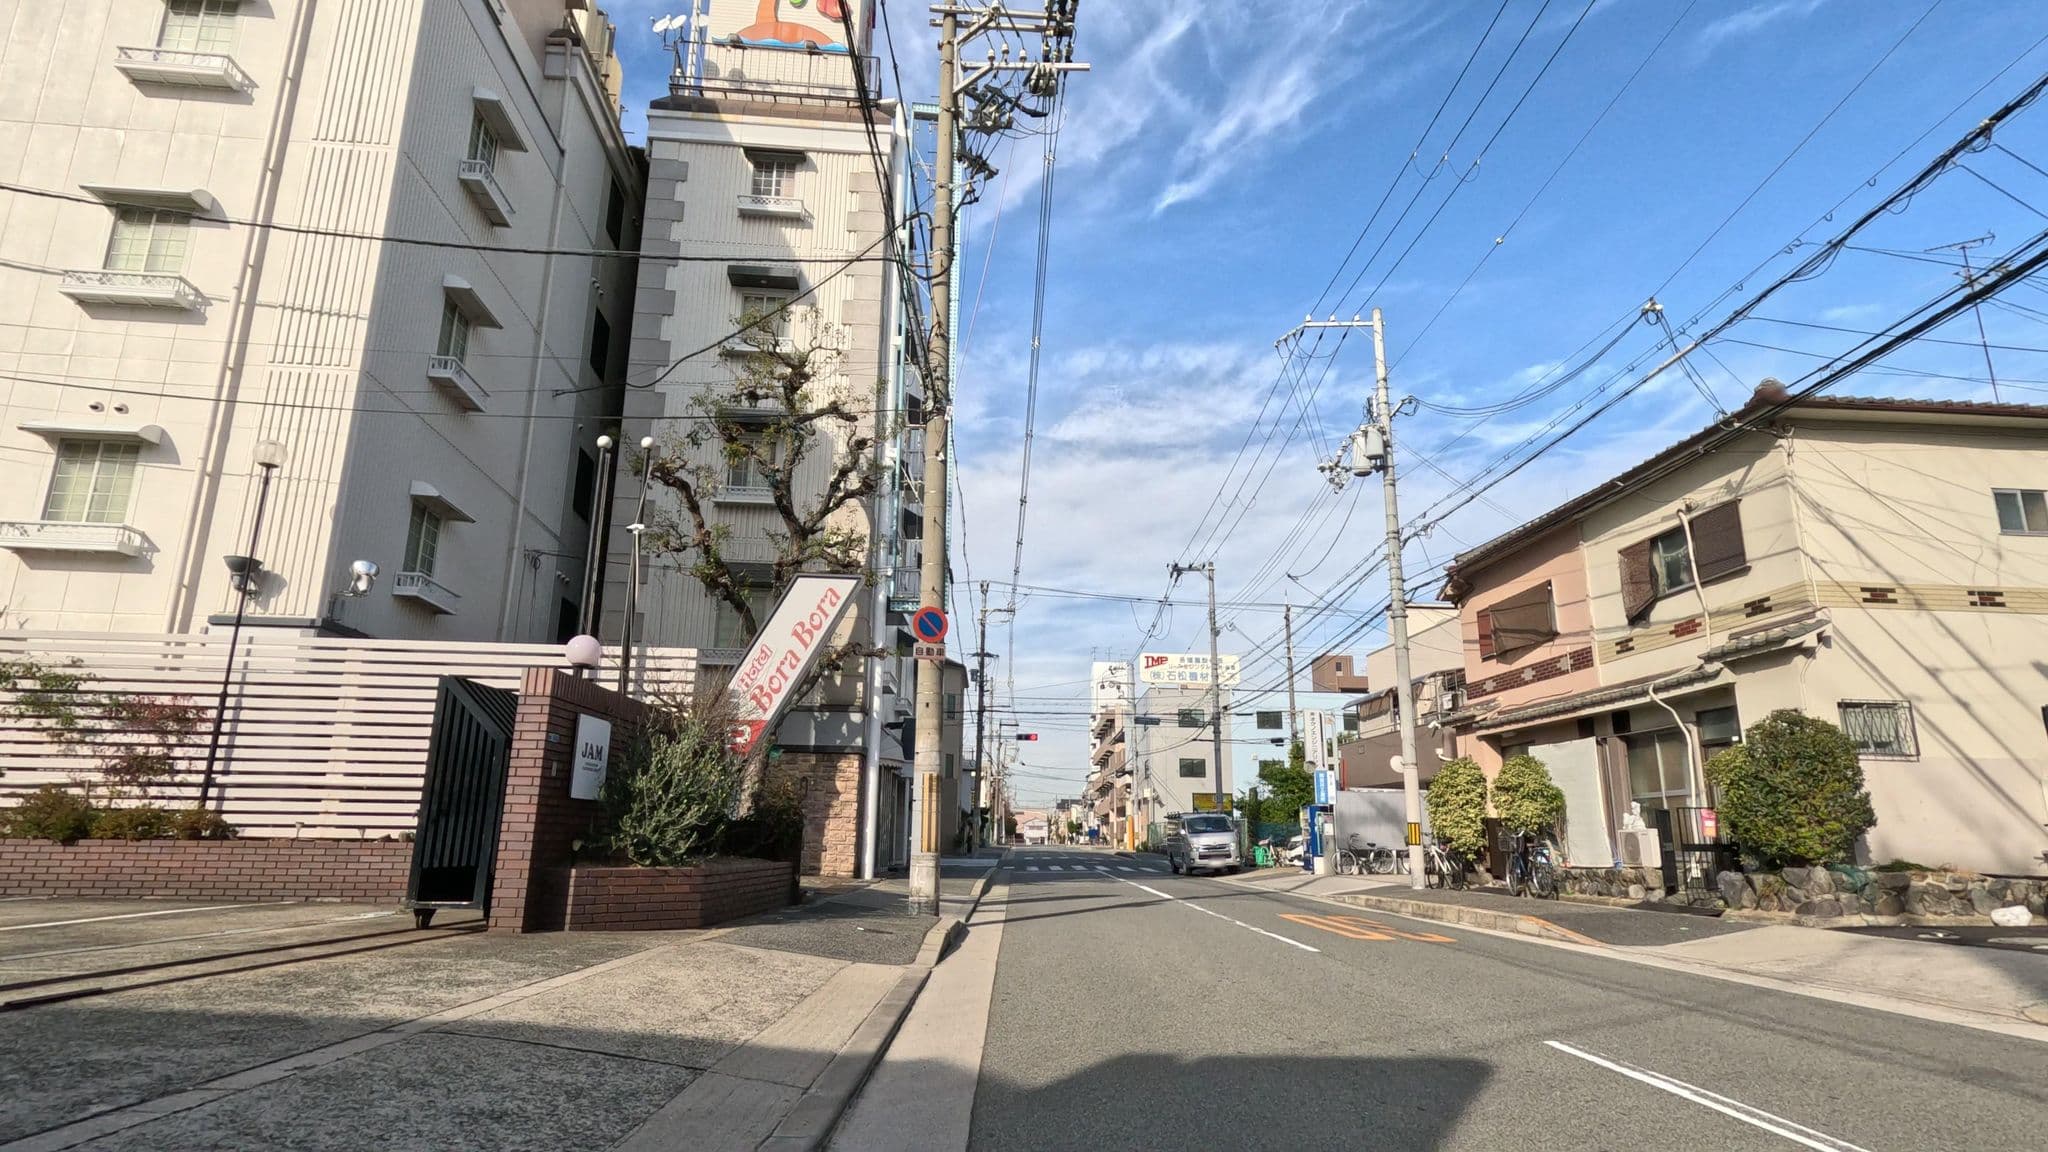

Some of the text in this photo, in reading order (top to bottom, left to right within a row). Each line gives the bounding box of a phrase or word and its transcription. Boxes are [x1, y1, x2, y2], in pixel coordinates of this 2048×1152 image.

[737, 643, 774, 689] Hotel
[751, 587, 841, 714] Bora Bora
[915, 646, 944, 657] 自動車
[581, 742, 604, 761] JAM
